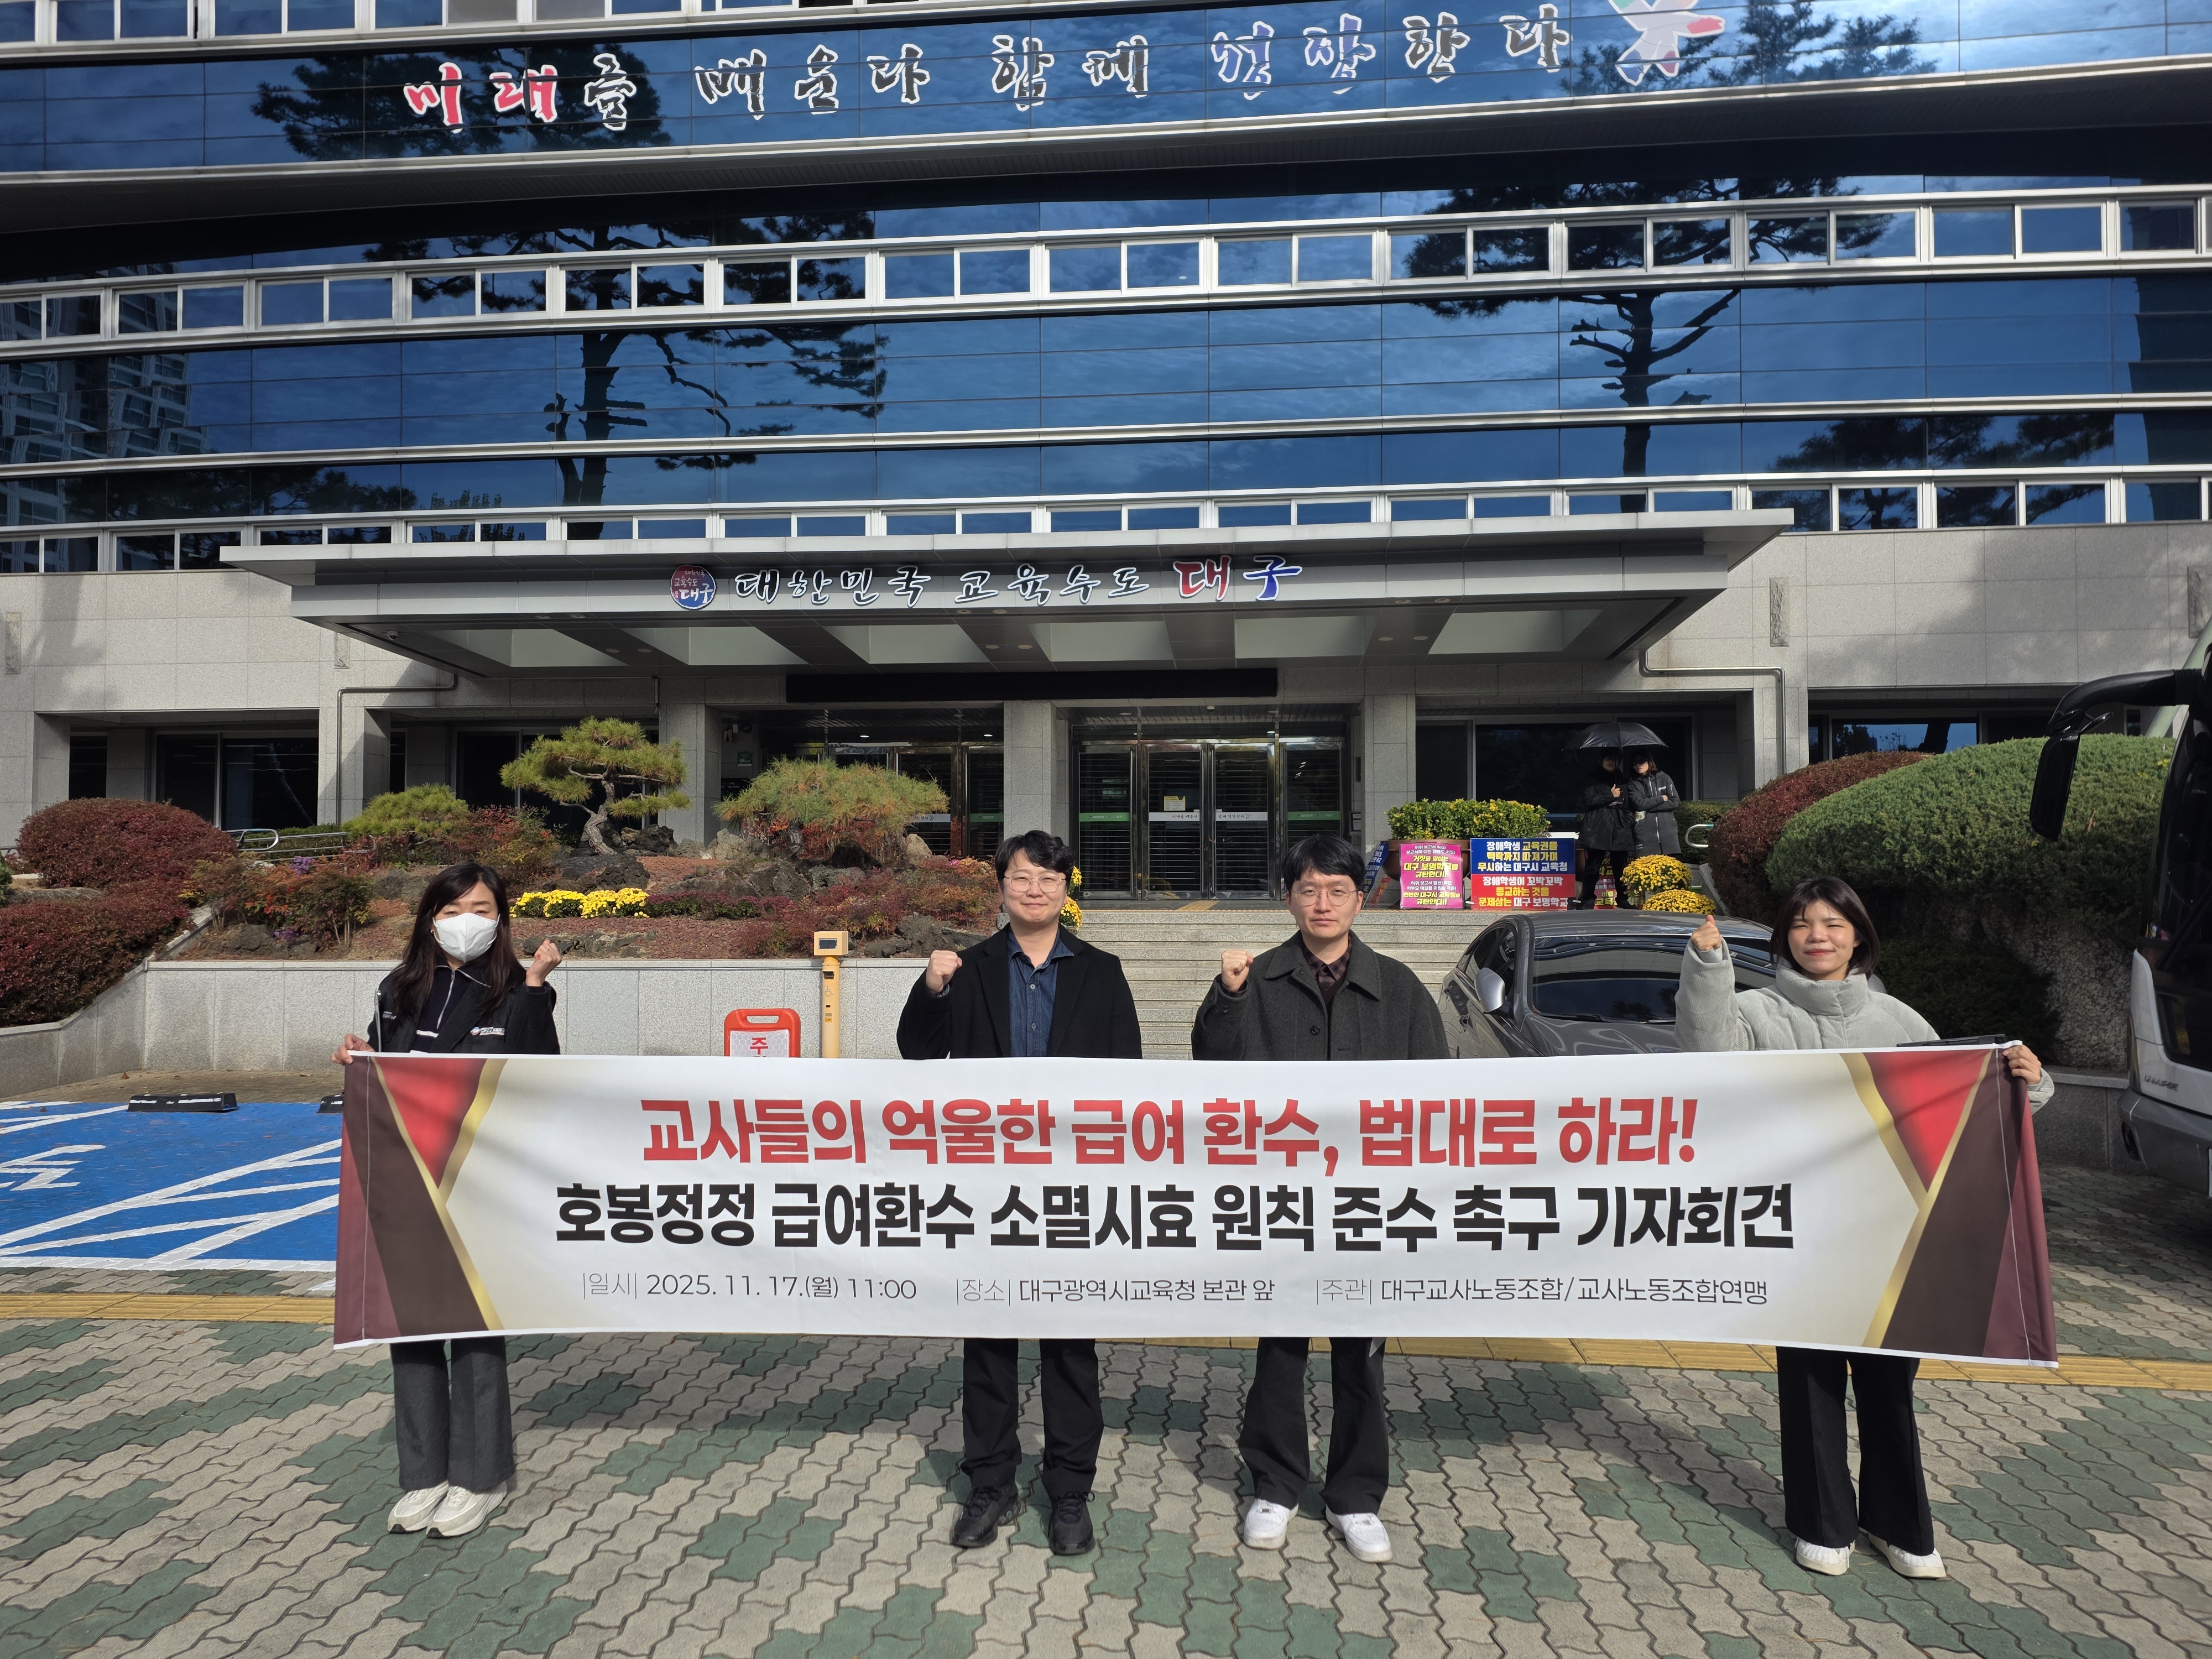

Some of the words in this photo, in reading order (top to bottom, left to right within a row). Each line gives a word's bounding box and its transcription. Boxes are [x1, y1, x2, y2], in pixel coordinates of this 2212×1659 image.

[403, 53, 637, 134] 미래를
[992, 34, 1149, 112] 함께
[1211, 4, 1572, 100] 성장한다
[674, 575, 698, 588] 교육수도
[734, 565, 931, 608] 대한민국
[954, 563, 1150, 606] 교육수도
[1173, 555, 1303, 601] 대구
[679, 583, 714, 604] 대구
[1486, 841, 1521, 851] 장애학생
[1522, 842, 1558, 851] 교육권을
[1486, 852, 1520, 861] 맥락까지
[1522, 852, 1558, 861] 따져가며
[1478, 862, 1512, 872] 무시하는
[1513, 862, 1539, 872] 대구시
[1541, 862, 1568, 872] 교육청
[1483, 876, 1525, 886] 장애학생이
[1527, 877, 1563, 886] 꼬박꼬박
[1495, 887, 1530, 896] 등교하는
[1531, 887, 1550, 896] 것을
[1478, 898, 1512, 907] 문제삼는
[1513, 898, 1531, 907] 대구
[1532, 897, 1568, 907] 보명학교
[640, 1099, 867, 1163] 교사들의
[881, 1098, 1056, 1165] 억울한
[1071, 1099, 1185, 1164] 급여
[1203, 1098, 1339, 1177] 환수,
[1359, 1098, 1537, 1167] 법대로
[1557, 1097, 1698, 1165] 하라!
[556, 1182, 755, 1246] 호봉정정
[771, 1182, 975, 1249] 급여환수
[990, 1184, 1197, 1249] 소멸시효
[1212, 1185, 1314, 1251] 원칙
[1332, 1186, 1438, 1253] 준수
[1453, 1185, 1561, 1250] 촉구
[1577, 1183, 1794, 1249] 기자회견
[646, 1274, 717, 1296] 2025.
[724, 1274, 760, 1296] 11.
[847, 1277, 917, 1299] 11:00
[1019, 1279, 1197, 1302] 대구광역시교육청
[1202, 1279, 1248, 1302] 본관
[1254, 1279, 1275, 1302] 앞
